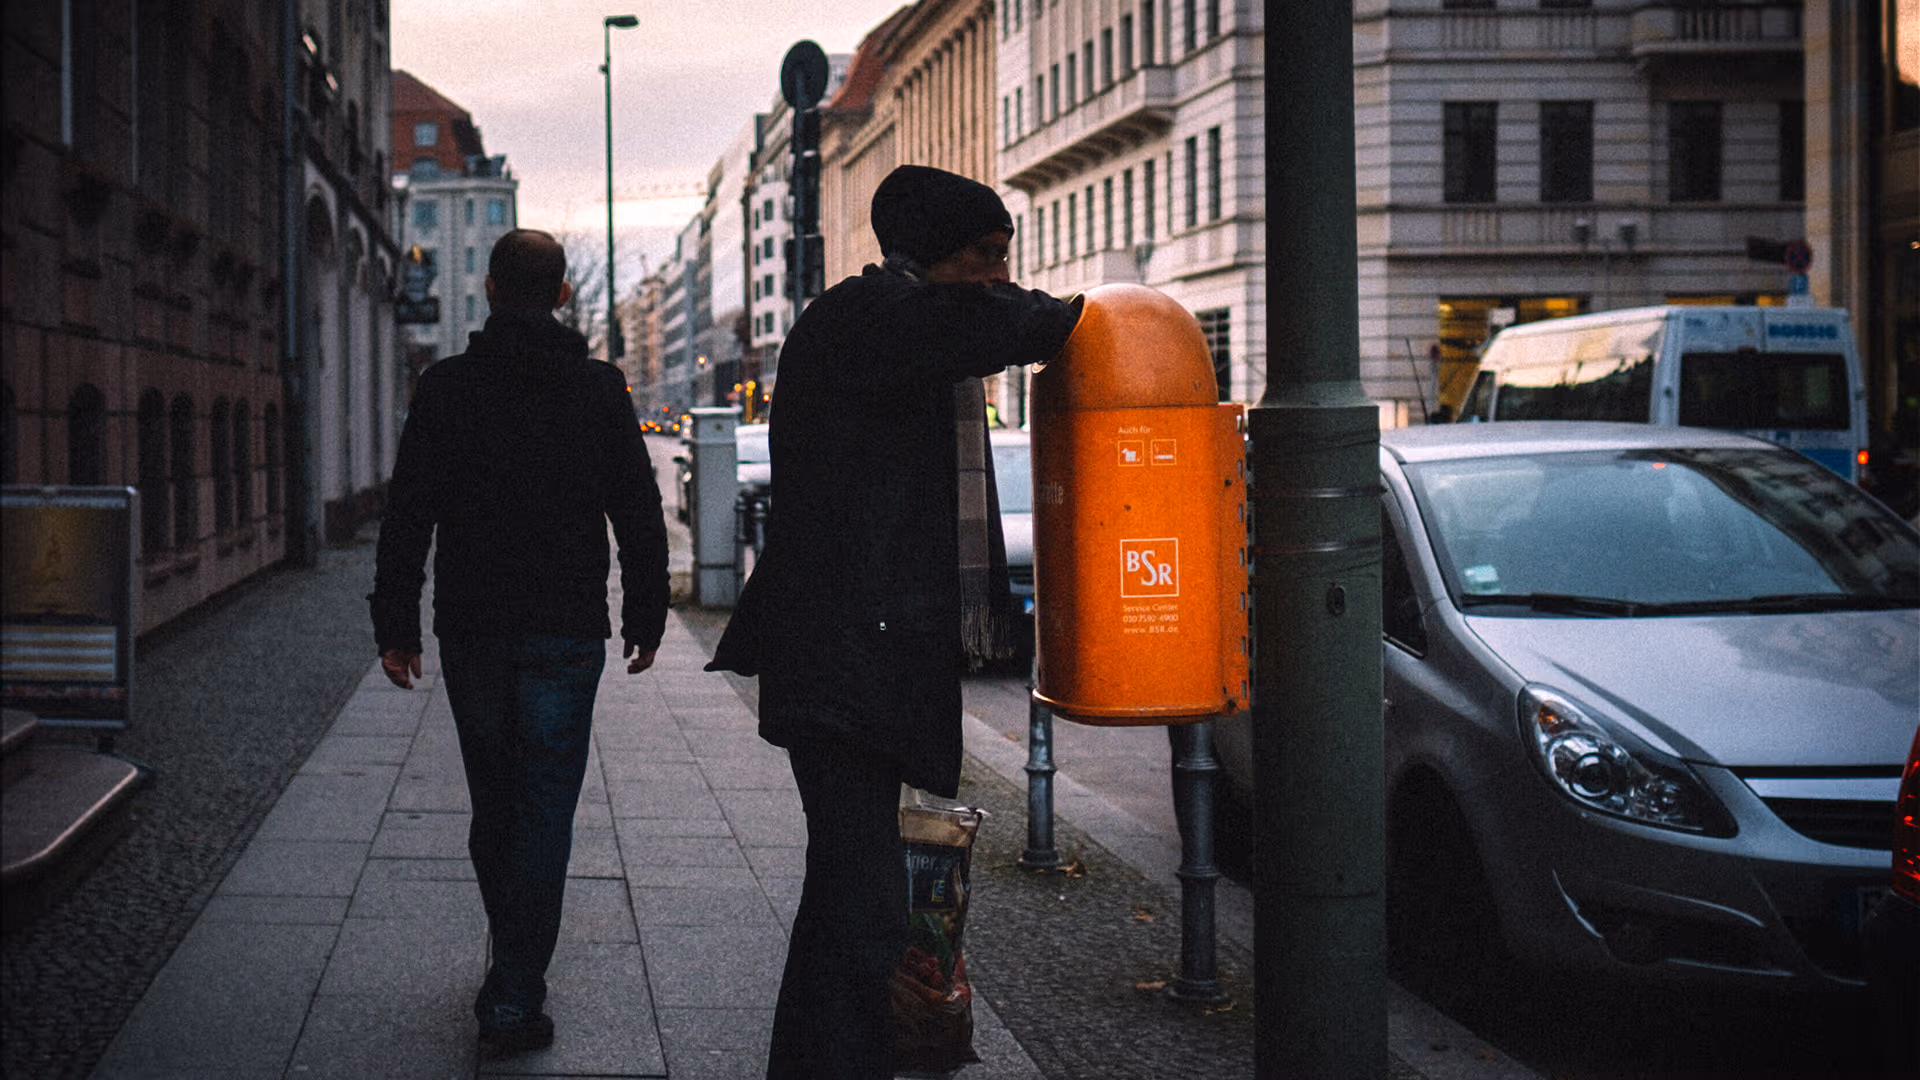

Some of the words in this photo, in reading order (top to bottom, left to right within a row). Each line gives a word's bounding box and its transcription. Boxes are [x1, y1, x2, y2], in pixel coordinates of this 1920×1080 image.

[1118, 426, 1138, 434] Auch
[1127, 550, 1173, 586] BSR
[1123, 604, 1150, 612] Service
